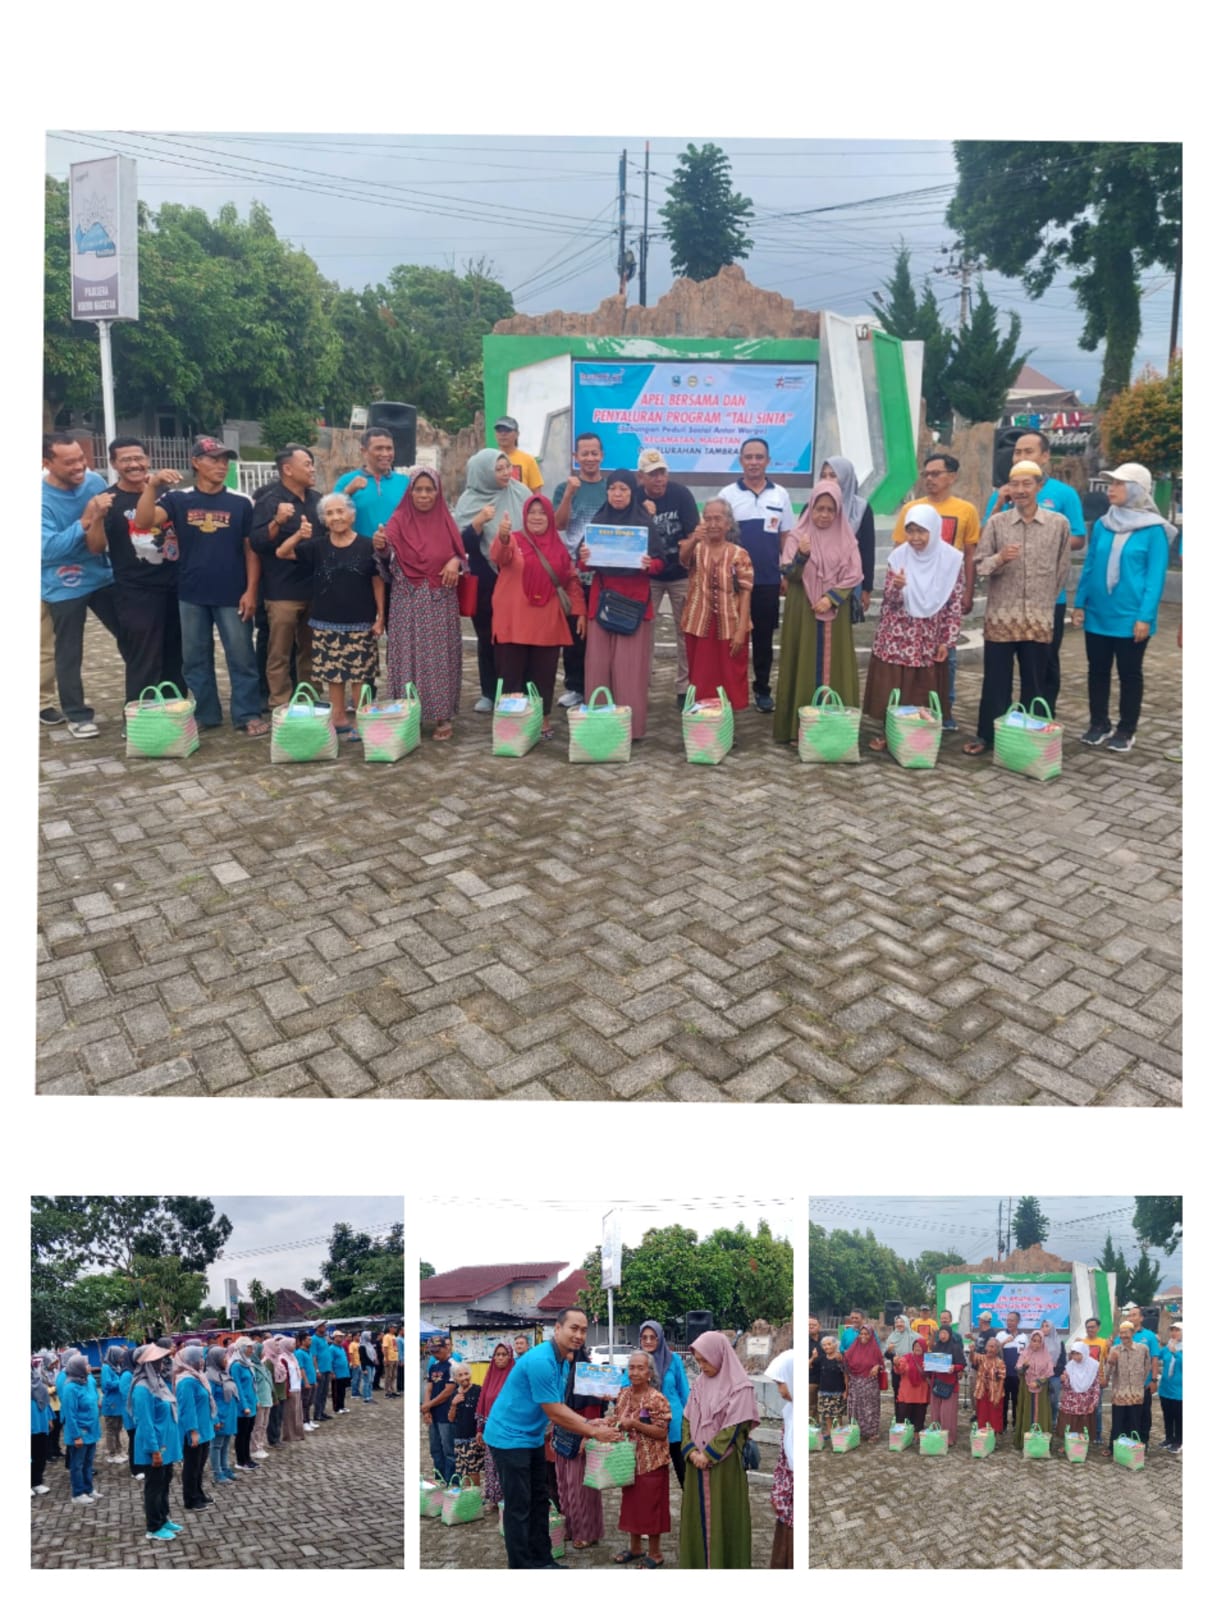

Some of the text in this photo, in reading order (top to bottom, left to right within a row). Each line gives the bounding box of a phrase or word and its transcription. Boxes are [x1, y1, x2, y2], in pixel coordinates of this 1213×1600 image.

[641, 393, 746, 406] APEL BERSAMA DAN
[593, 410, 662, 423] PENYALURAN
[667, 411, 721, 424] PROGRAM
[704, 447, 741, 455] TAMBRA
